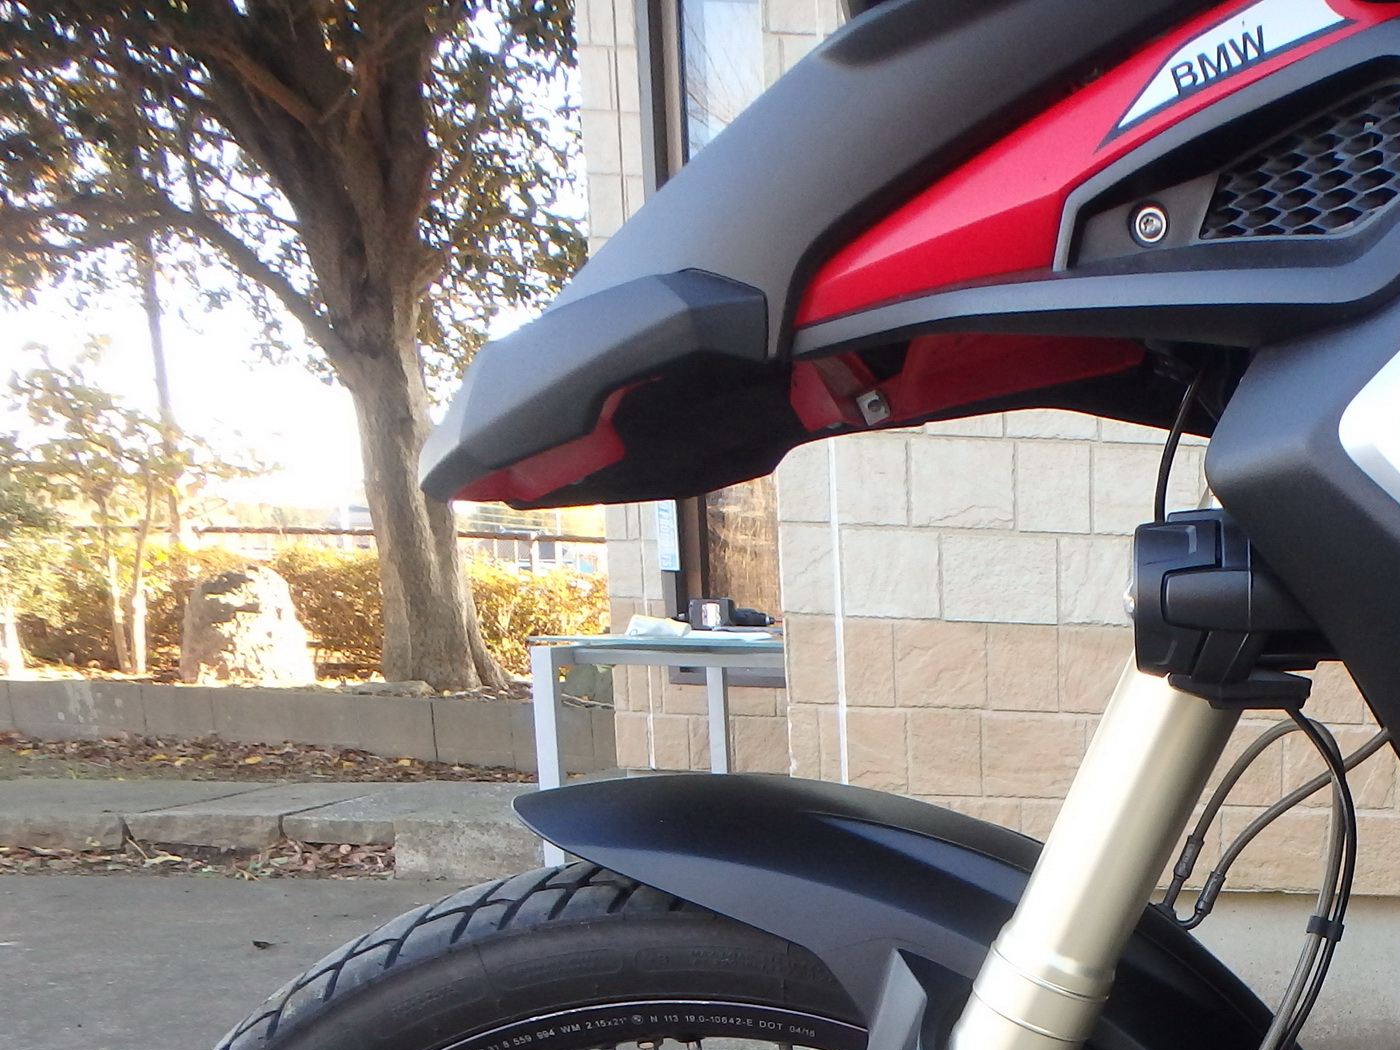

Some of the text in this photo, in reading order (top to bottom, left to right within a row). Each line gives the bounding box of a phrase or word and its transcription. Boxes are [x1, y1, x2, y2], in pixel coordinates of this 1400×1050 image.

[1171, 25, 1264, 94] BMW
[512, 1034, 532, 1047] 559
[536, 1028, 555, 1041] 994
[560, 1022, 581, 1034] WM
[650, 1015, 659, 1023] N
[664, 1014, 679, 1023] 113
[759, 1019, 783, 1031] DOT
